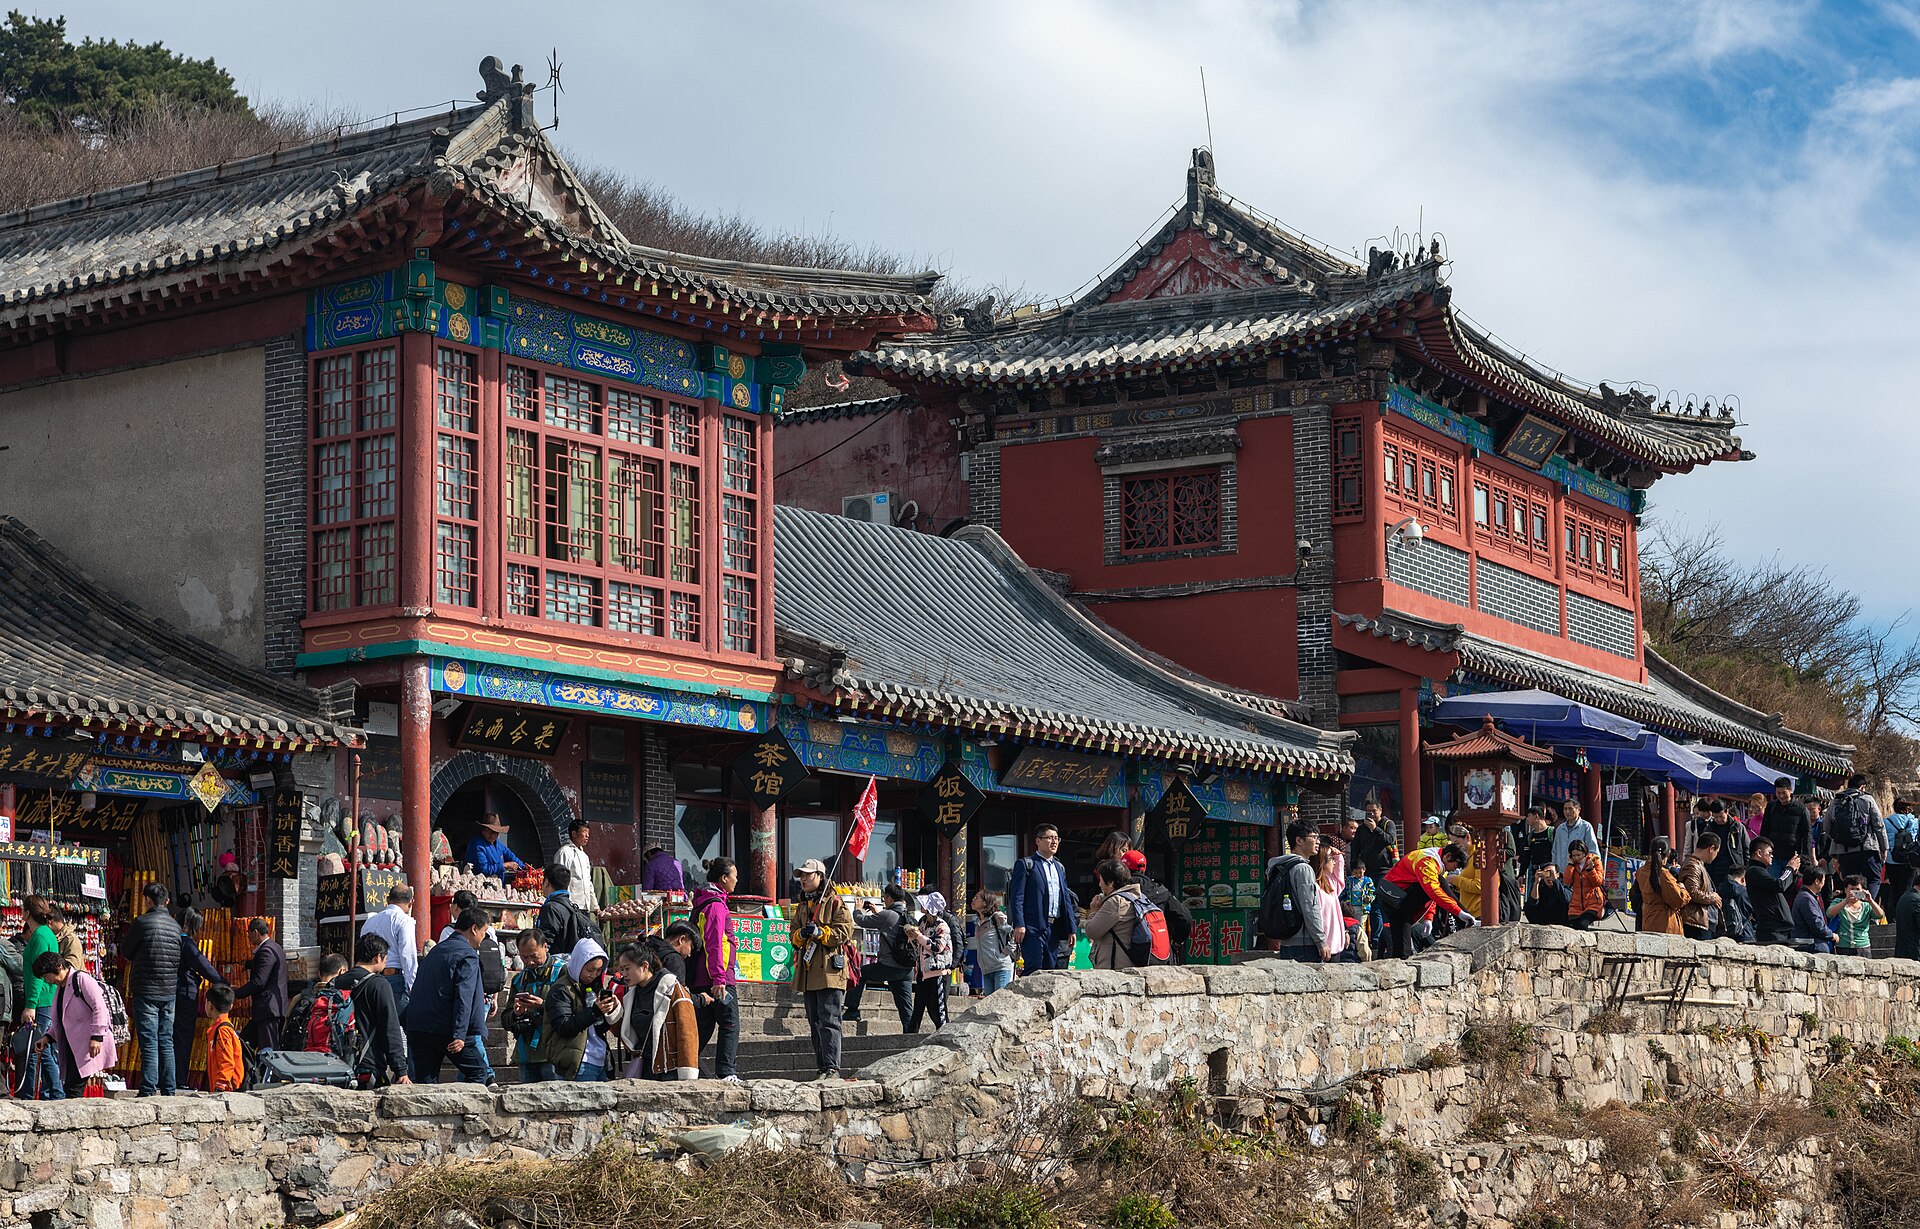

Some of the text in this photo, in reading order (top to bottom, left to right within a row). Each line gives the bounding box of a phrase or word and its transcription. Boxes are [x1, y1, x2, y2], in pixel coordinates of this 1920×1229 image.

[750, 742, 788, 796] 茶馆
[276, 793, 301, 807] 泰山
[934, 775, 965, 824] 饭店
[1165, 792, 1191, 839] 拉面
[271, 812, 298, 877] 请香处
[319, 875, 362, 892] 奶油蛋
[365, 870, 404, 889] 泰山泉水
[317, 893, 359, 913] 冰淇
[1188, 919, 1212, 958] 烧
[1220, 920, 1245, 958] 拉
